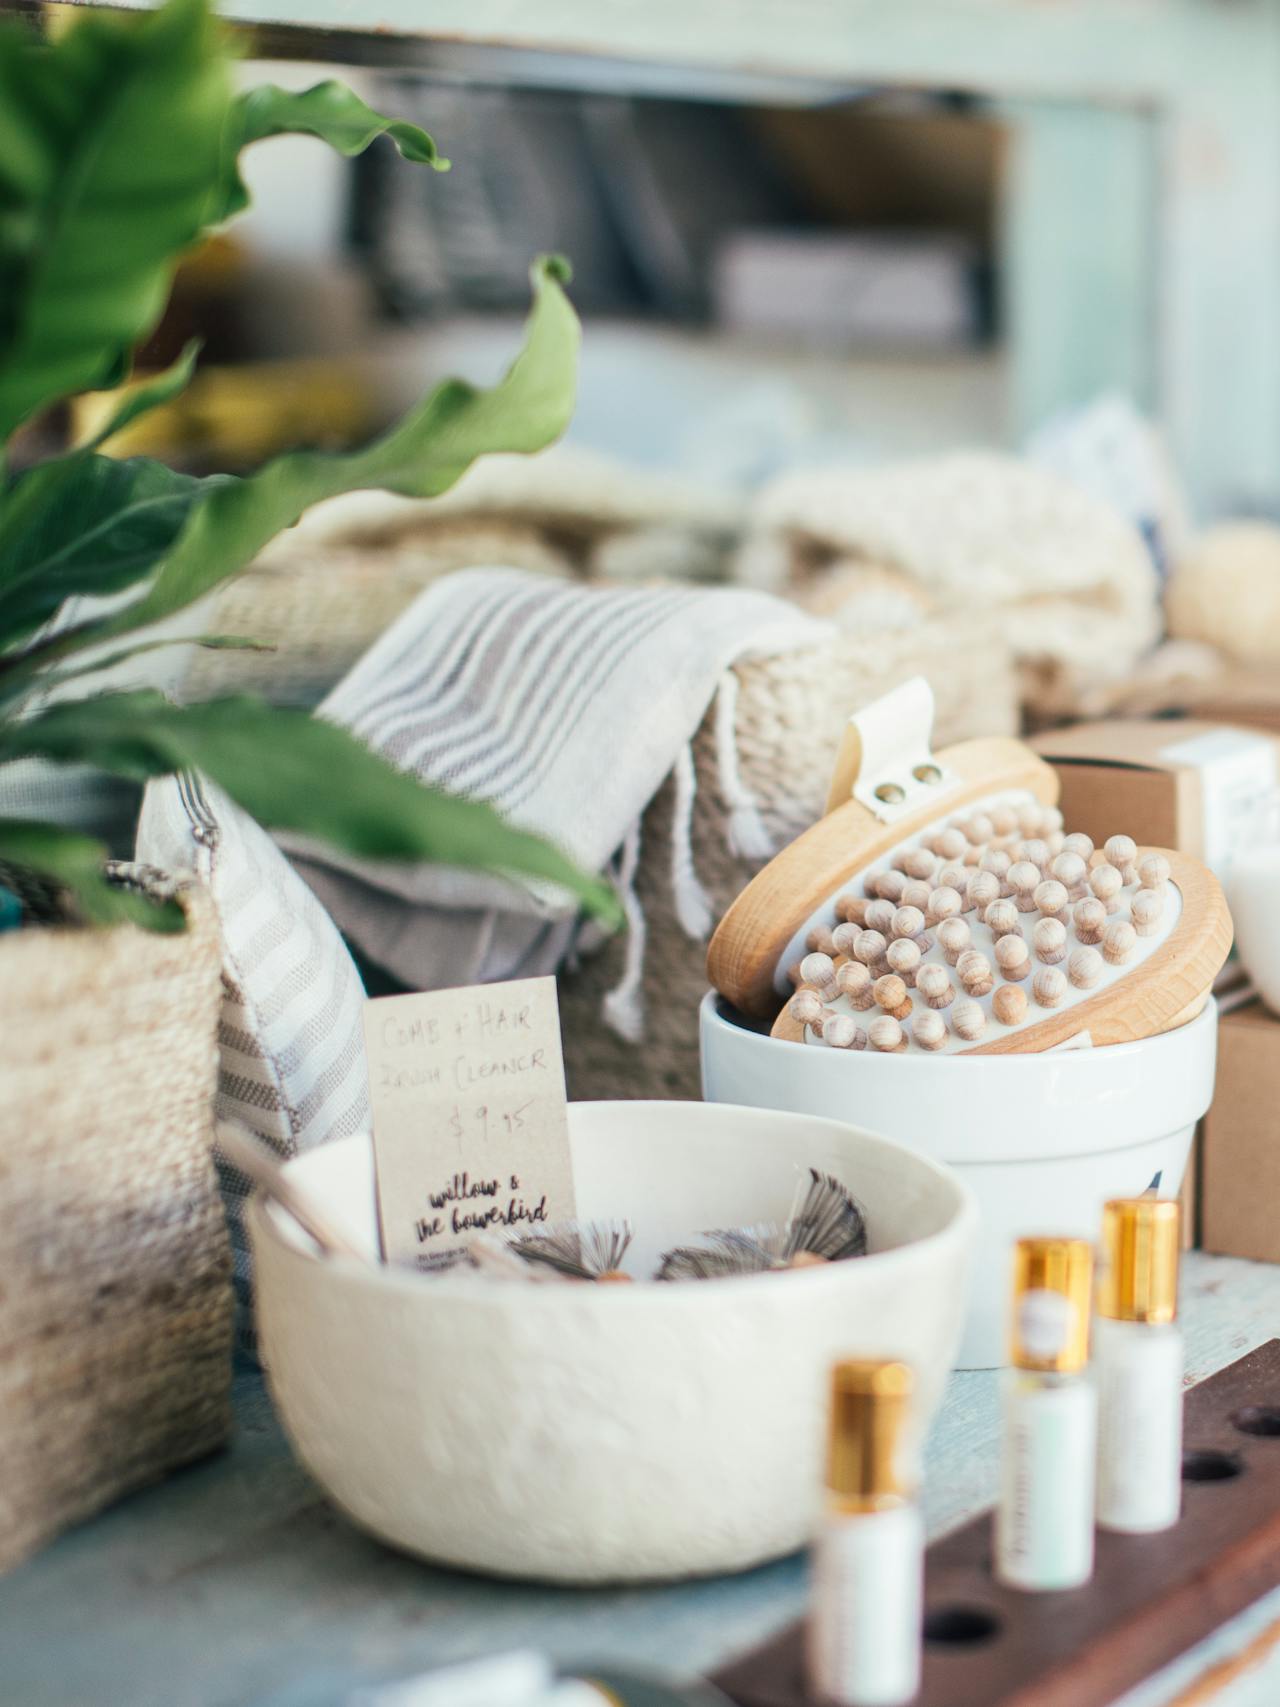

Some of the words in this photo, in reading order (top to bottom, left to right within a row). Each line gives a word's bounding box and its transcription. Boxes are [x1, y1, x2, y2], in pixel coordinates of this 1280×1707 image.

[477, 1002, 531, 1039] HAIR
[427, 1171, 501, 1209] willow
[451, 1196, 549, 1235] bowerbird
